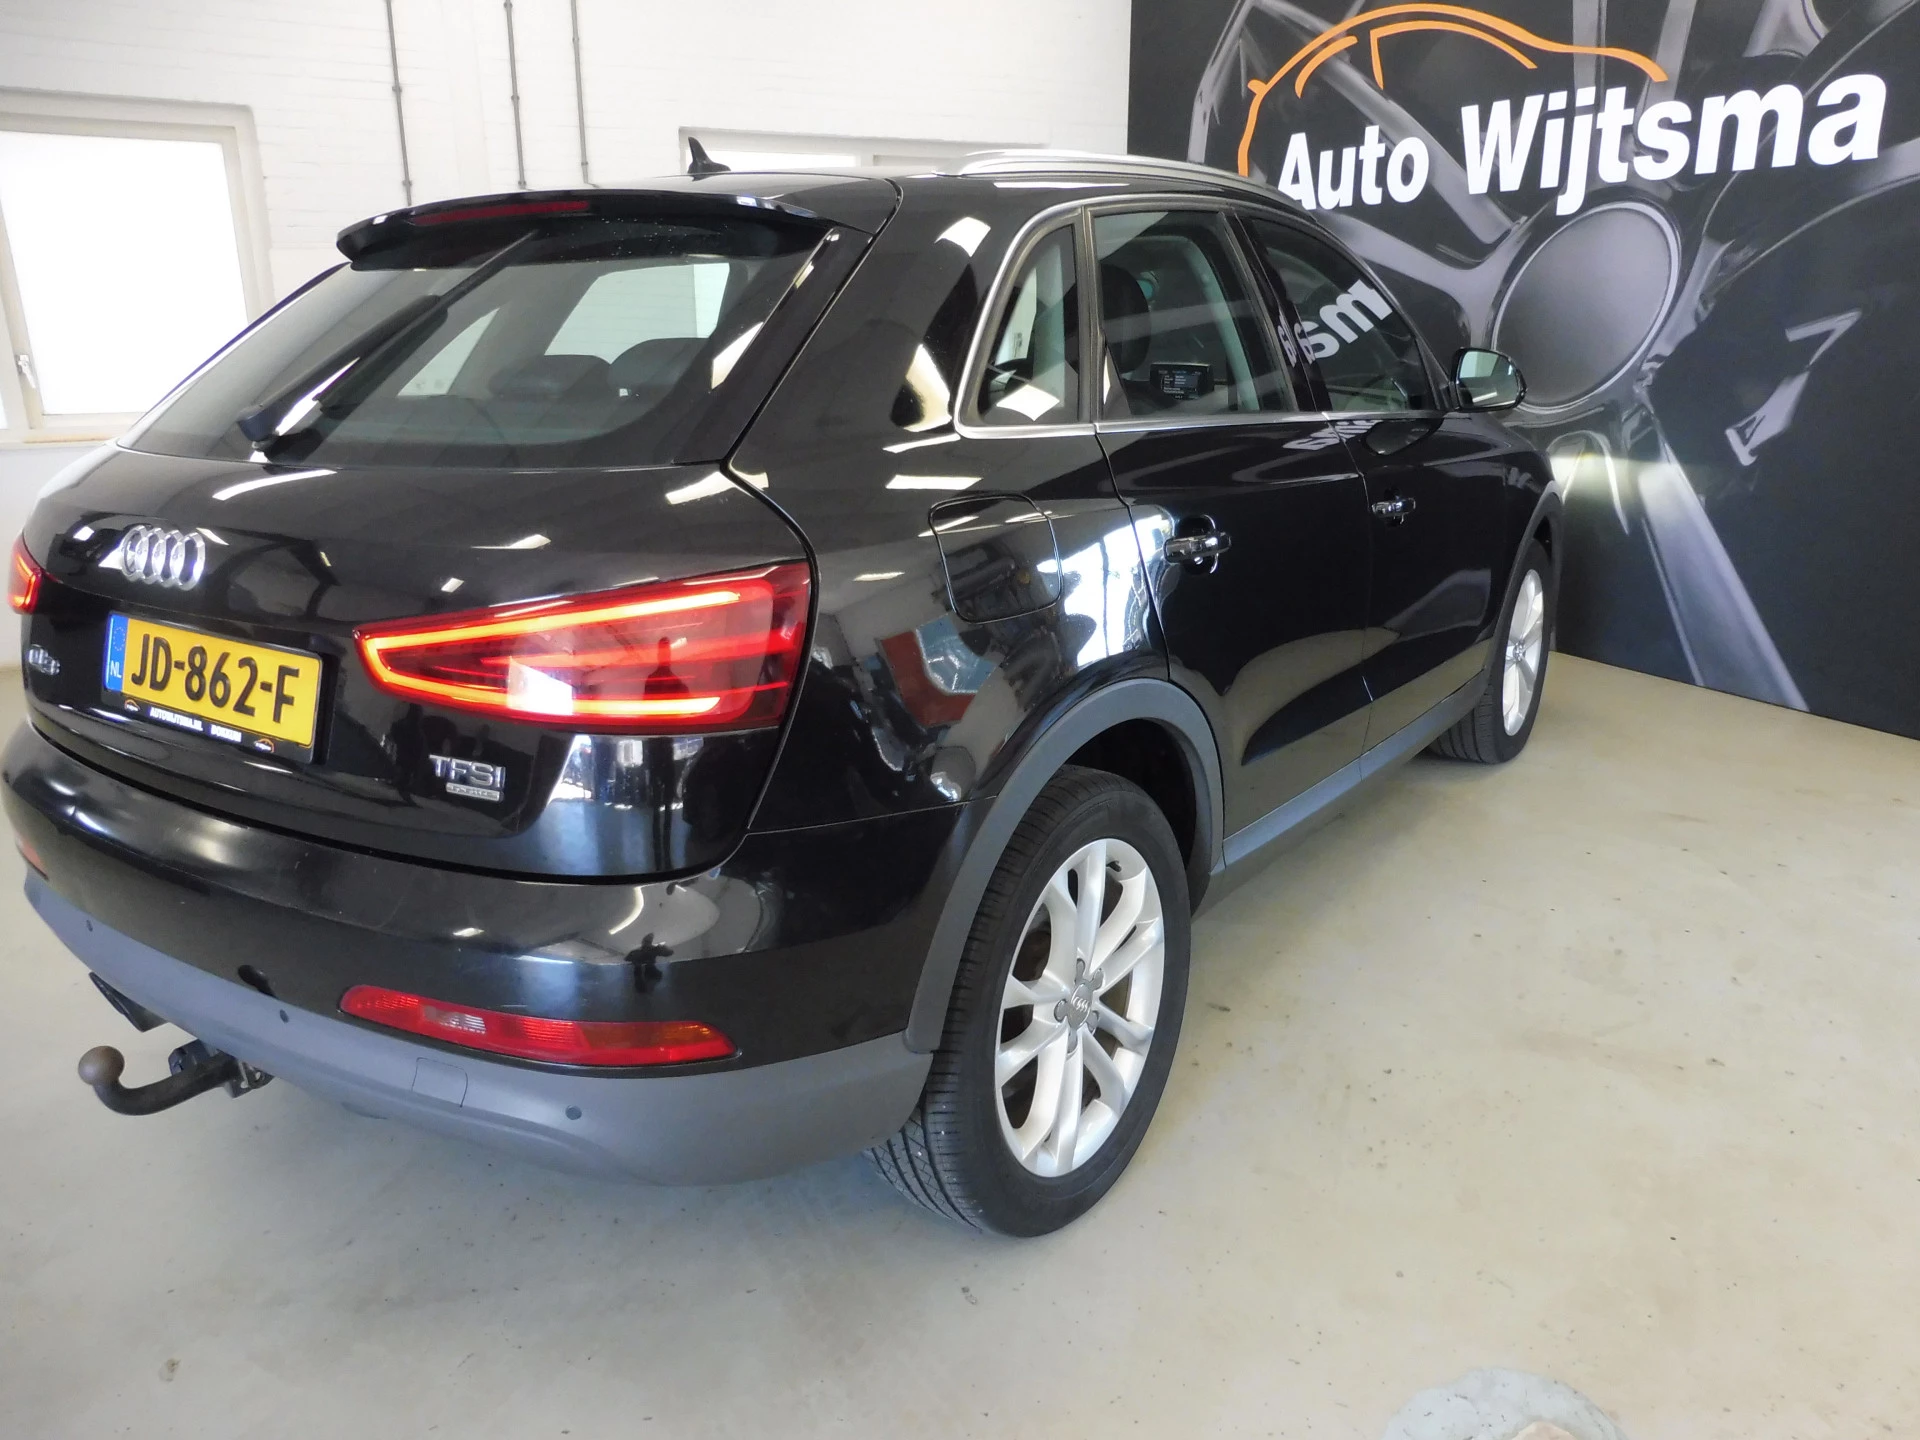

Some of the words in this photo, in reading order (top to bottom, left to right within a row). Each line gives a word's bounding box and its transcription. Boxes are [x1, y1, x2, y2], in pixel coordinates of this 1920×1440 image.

[1278, 124, 1430, 211] Auto
[1460, 73, 1887, 216] Wijtsma
[109, 659, 122, 679] NL
[131, 633, 300, 724] JD-862-F
[429, 753, 506, 790] TFSI
